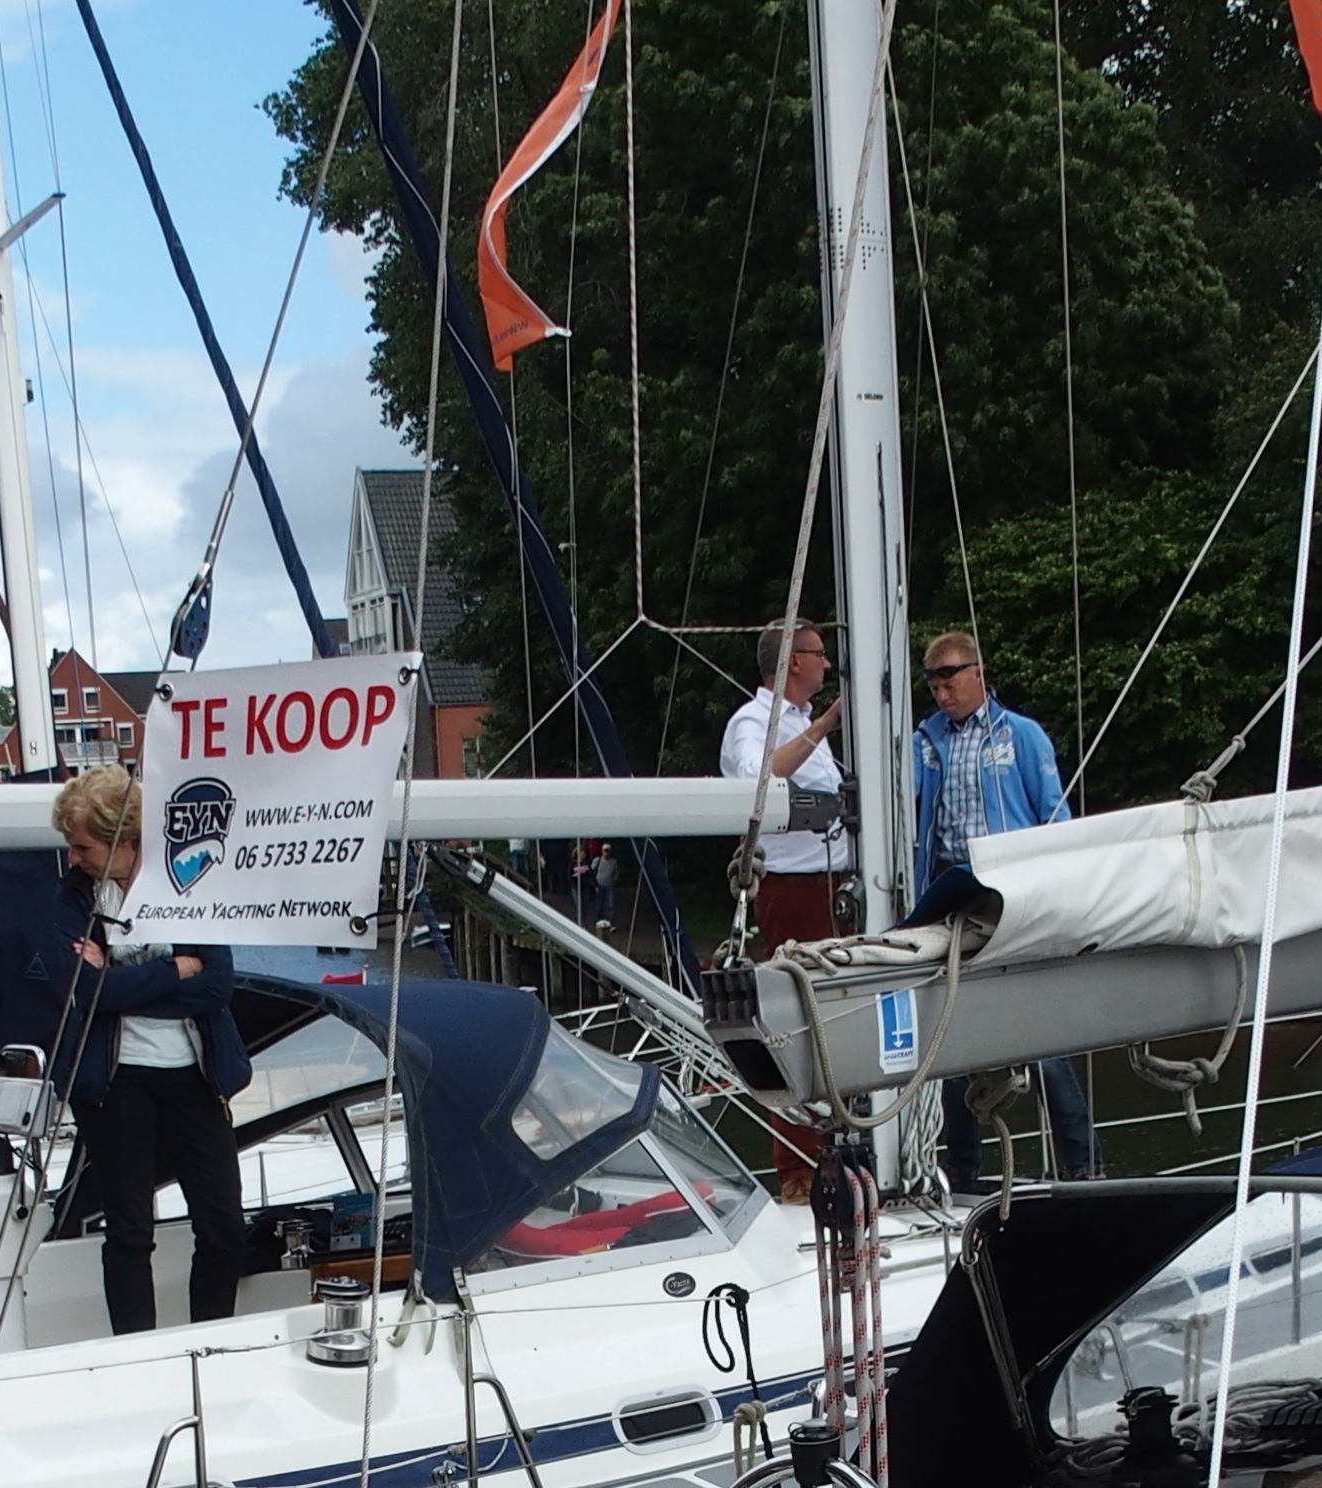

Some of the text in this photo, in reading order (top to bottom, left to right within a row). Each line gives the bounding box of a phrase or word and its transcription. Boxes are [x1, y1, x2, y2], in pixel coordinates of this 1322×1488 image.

[171, 685, 396, 759] TE KOOP
[165, 799, 236, 843] EYN
[245, 799, 373, 828] WWW.E-Y-N.COM
[234, 837, 364, 870] 06 5733 2267
